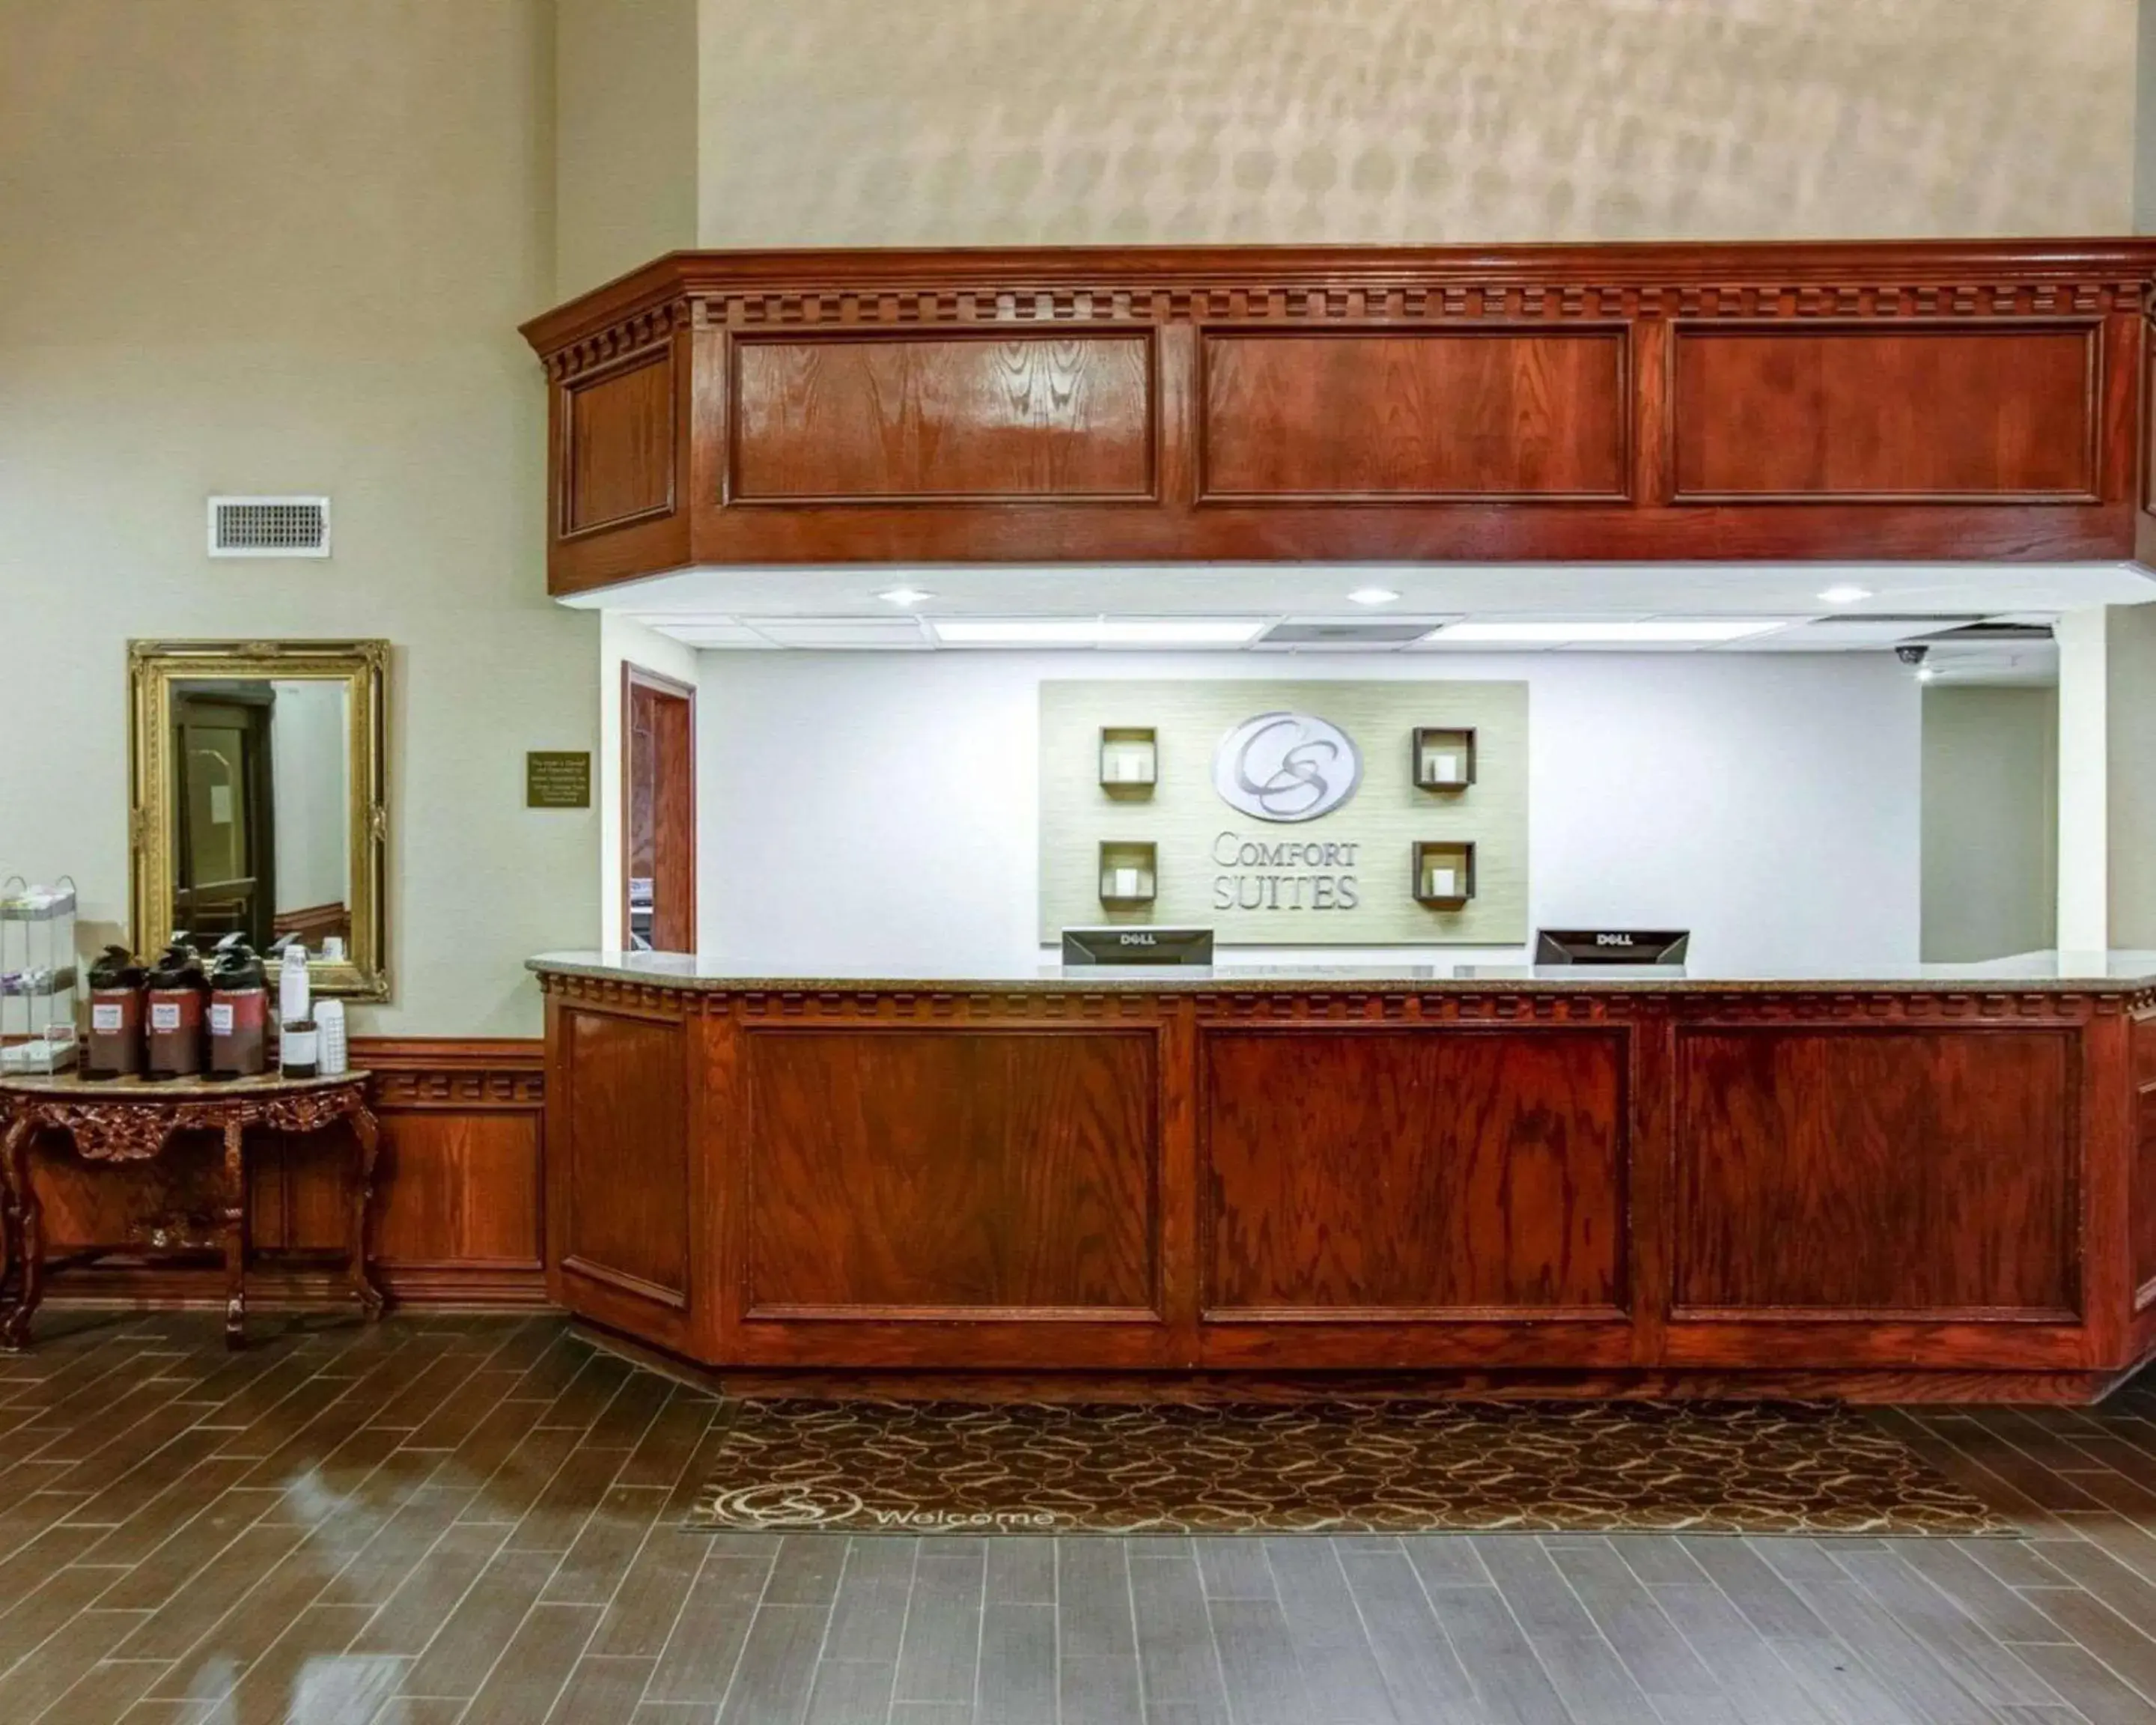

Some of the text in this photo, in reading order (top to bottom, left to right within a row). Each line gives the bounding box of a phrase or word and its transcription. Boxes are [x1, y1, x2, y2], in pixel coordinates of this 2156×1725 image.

[1211, 831, 1361, 867] COMFORT
[1212, 874, 1359, 910] SUITES
[1120, 933, 1157, 946] DELL
[1596, 934, 1633, 946] DELL
[876, 1509, 1056, 1525] Welcome
